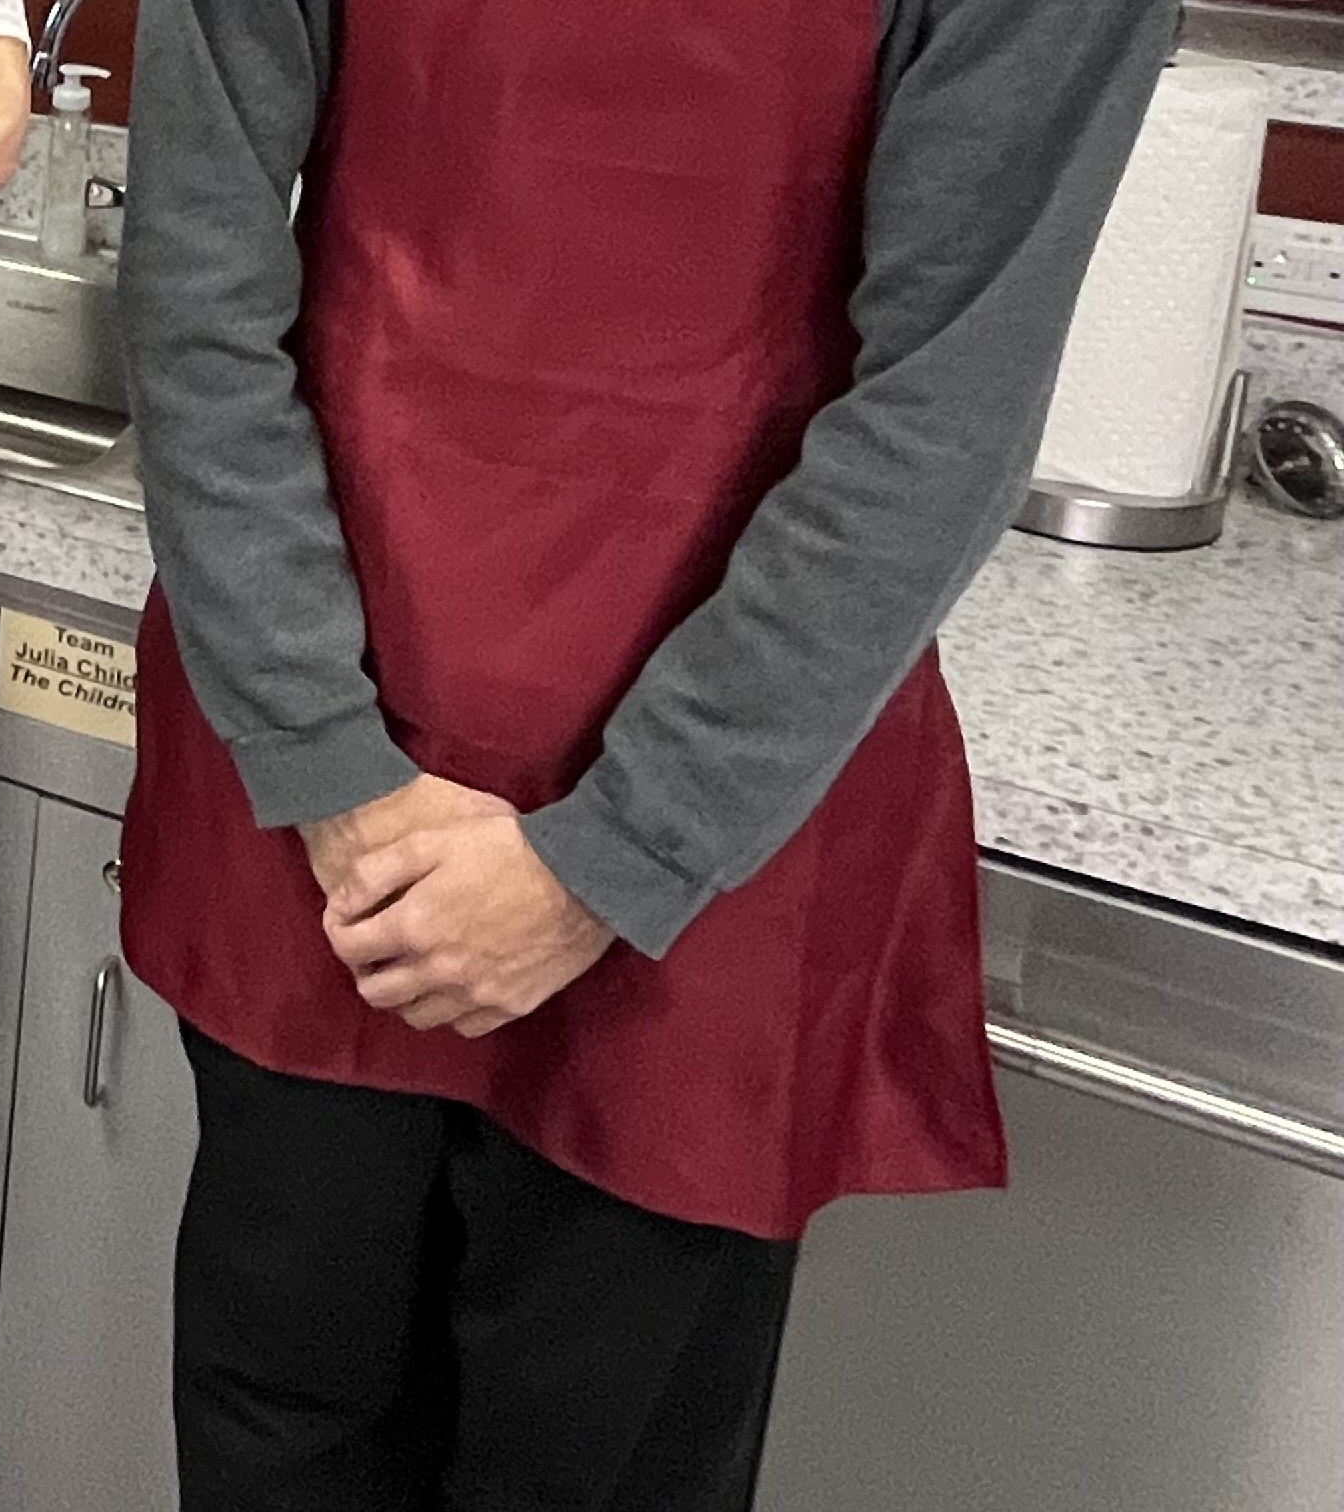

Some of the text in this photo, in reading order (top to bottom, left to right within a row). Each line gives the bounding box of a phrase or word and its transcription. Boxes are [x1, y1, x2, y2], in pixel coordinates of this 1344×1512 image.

[14, 641, 69, 675] Julia
[54, 625, 115, 658] Team
[11, 663, 50, 691] The
